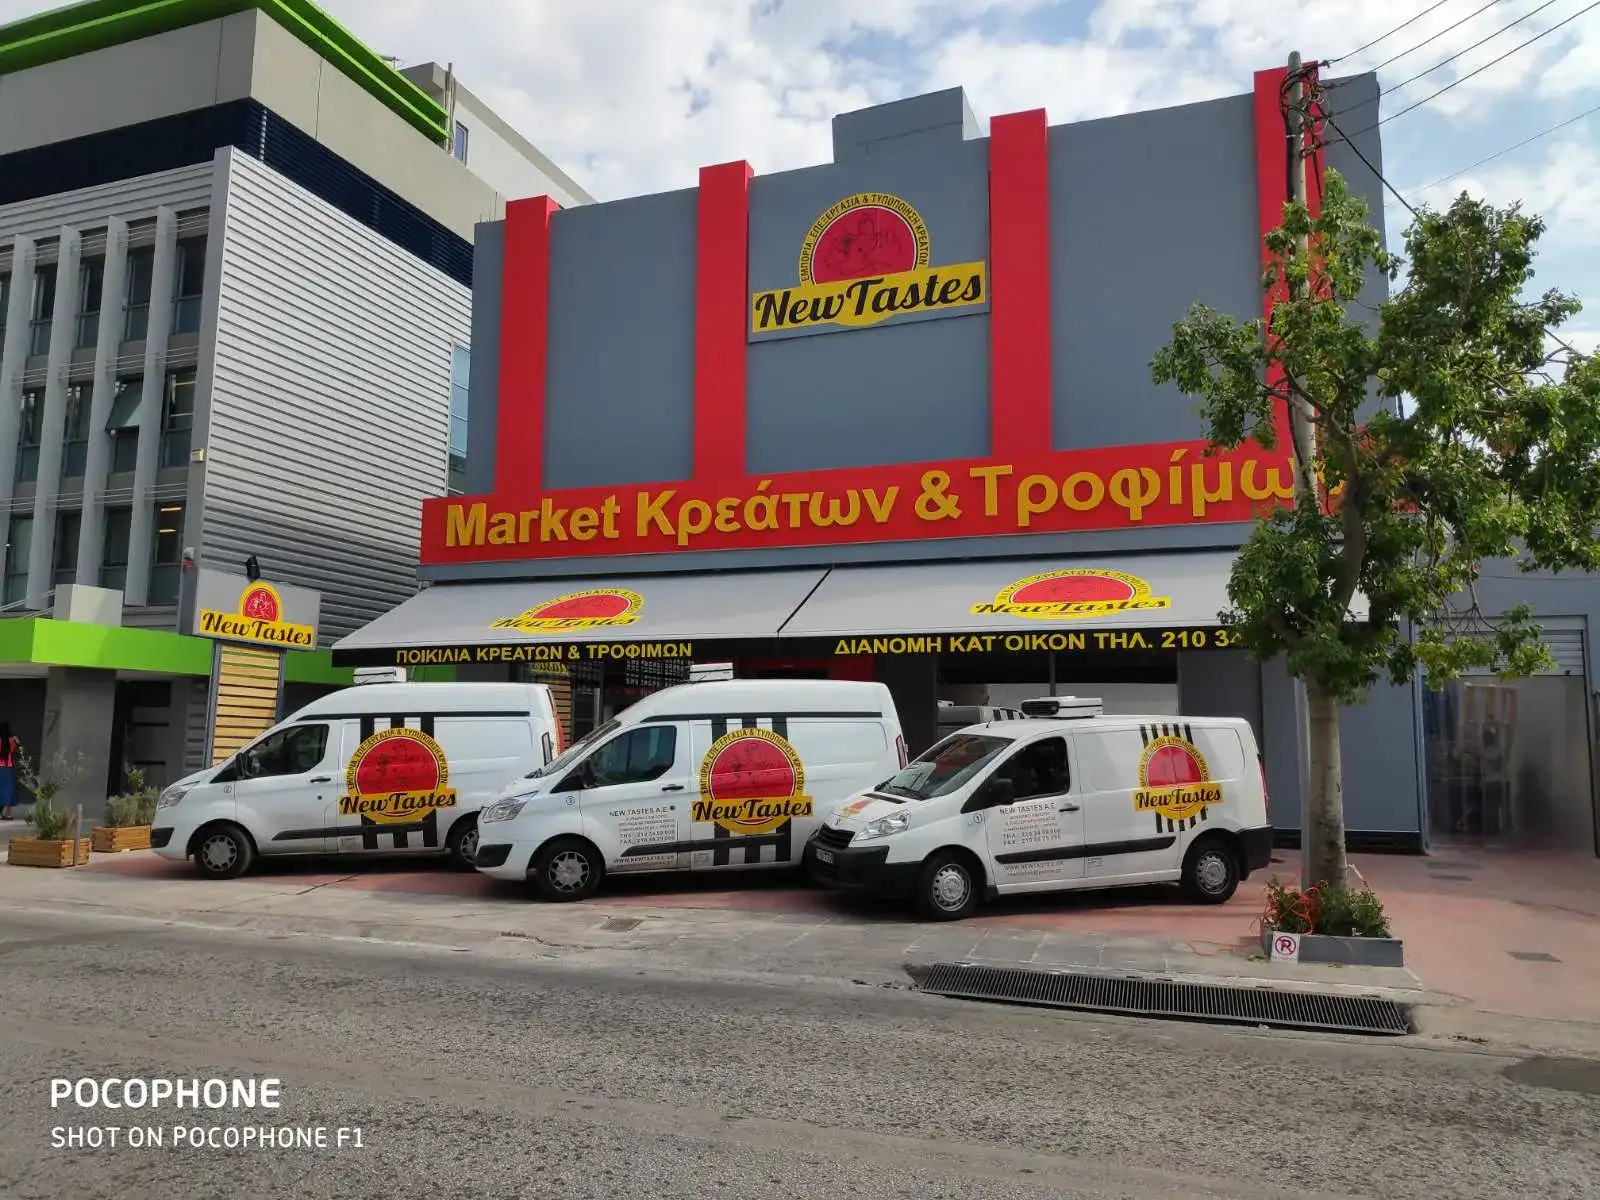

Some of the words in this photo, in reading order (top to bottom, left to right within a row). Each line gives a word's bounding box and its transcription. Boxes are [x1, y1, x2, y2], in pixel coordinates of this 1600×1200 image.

[872, 194, 919, 226] ΤΥΠΟΠΟΙΗΣΗ
[917, 223, 929, 266] ΚΡΕΑΤΩΝ
[445, 496, 621, 547] Market
[636, 480, 900, 546] Κρεάτων
[914, 470, 962, 521] &
[969, 449, 1346, 527] Τροφίμω
[396, 648, 470, 665] ΠΟΙΚΙΛΙΑ
[476, 645, 563, 663] ΚΡΕΑΤΩΝ
[567, 645, 581, 660] &
[586, 643, 693, 660] ΤΡΟΦΙΜΩΝ
[834, 637, 942, 655] ΔΙΑΝΟΜΗ
[1093, 631, 1153, 650] ΤΗΛ.
[1160, 630, 1207, 649] 210
[628, 807, 654, 815] TASTES
[1000, 807, 1015, 815] NEW
[1017, 804, 1043, 813] TASTES
